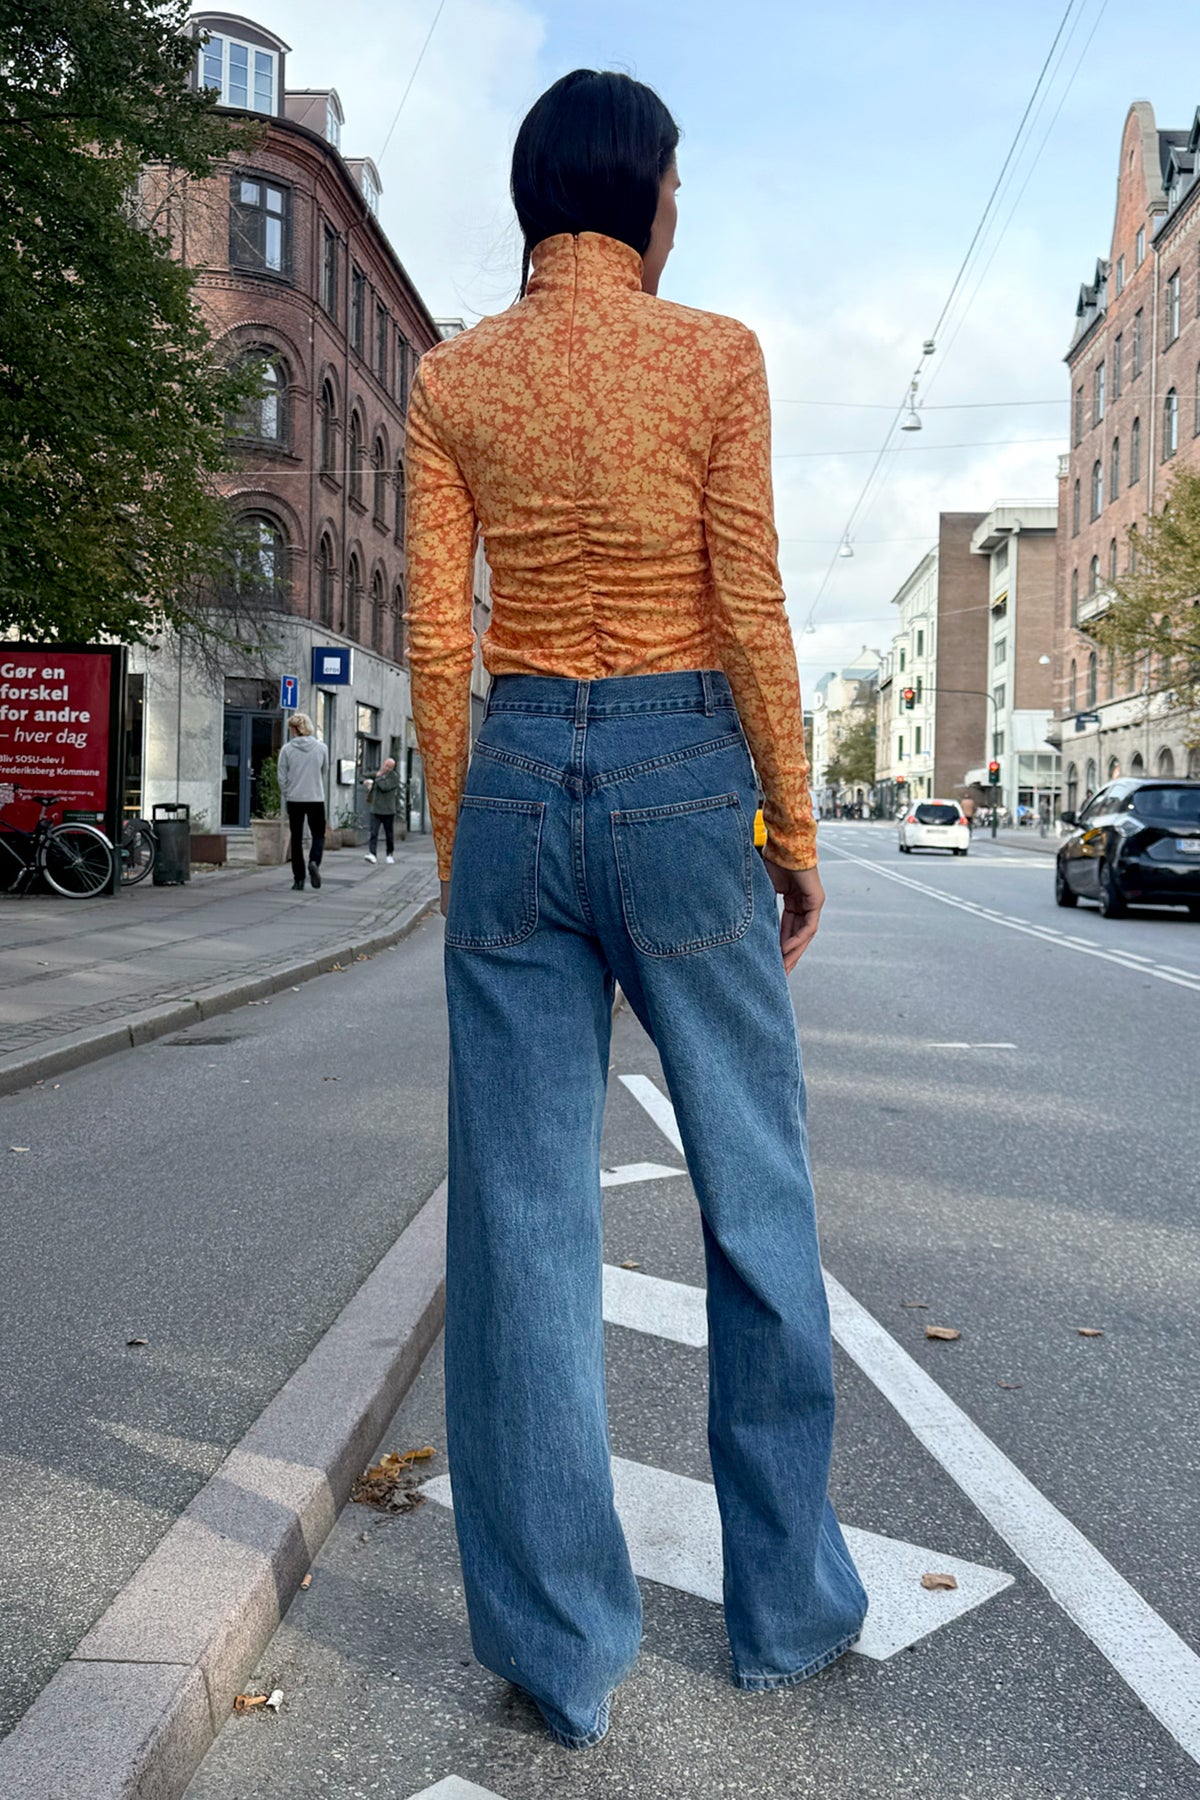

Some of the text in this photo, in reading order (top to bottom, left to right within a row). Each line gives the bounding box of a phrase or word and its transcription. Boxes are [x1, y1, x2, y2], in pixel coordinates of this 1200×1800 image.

[0, 663, 65, 679] Gør en
[0, 683, 69, 701] forskel
[0, 705, 91, 723] for andre
[14, 727, 52, 743] hver
[56, 728, 88, 749] dag
[15, 755, 60, 764] SOSU-elev
[61, 756, 65, 764] i
[56, 768, 100, 777] Kommune
